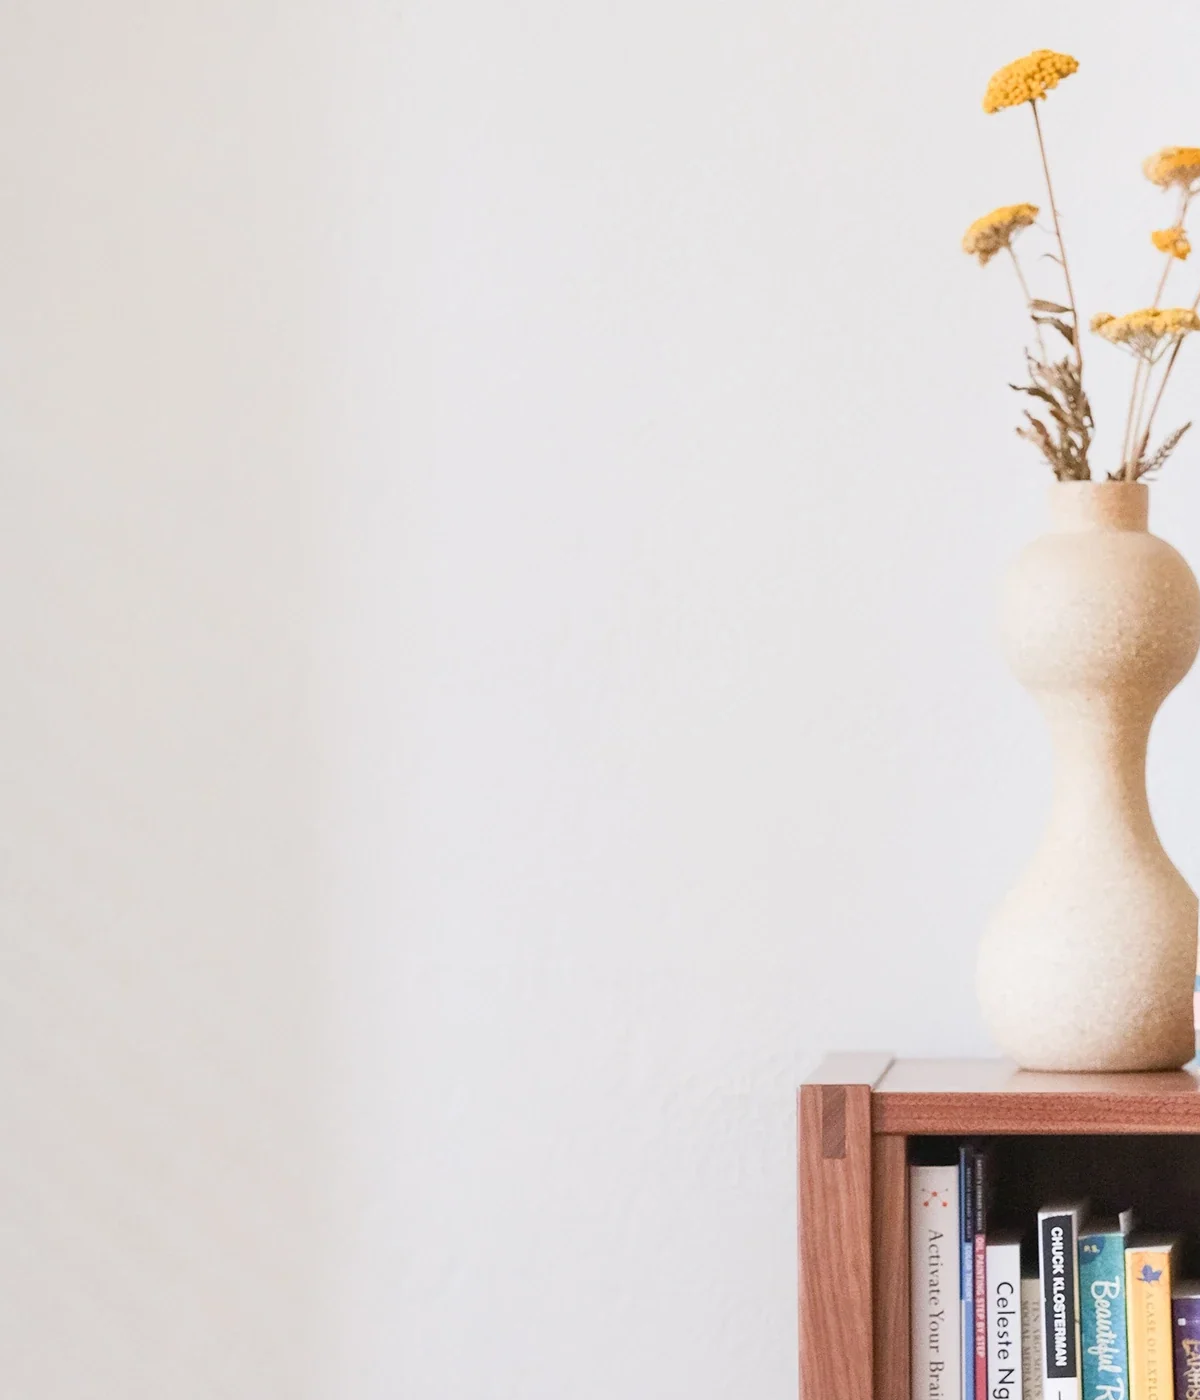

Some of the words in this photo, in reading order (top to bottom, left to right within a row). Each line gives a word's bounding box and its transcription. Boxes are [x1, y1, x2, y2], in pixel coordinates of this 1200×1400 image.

[928, 1229, 944, 1308] Activate
[1050, 1226, 1064, 1274] CHUCK
[929, 1311, 944, 1356] Your
[996, 1281, 1014, 1360] Celeste
[1052, 1277, 1068, 1367] KLOSTERMAN
[1087, 1275, 1121, 1372] Beautiful
[993, 1368, 1015, 1400] Ng
